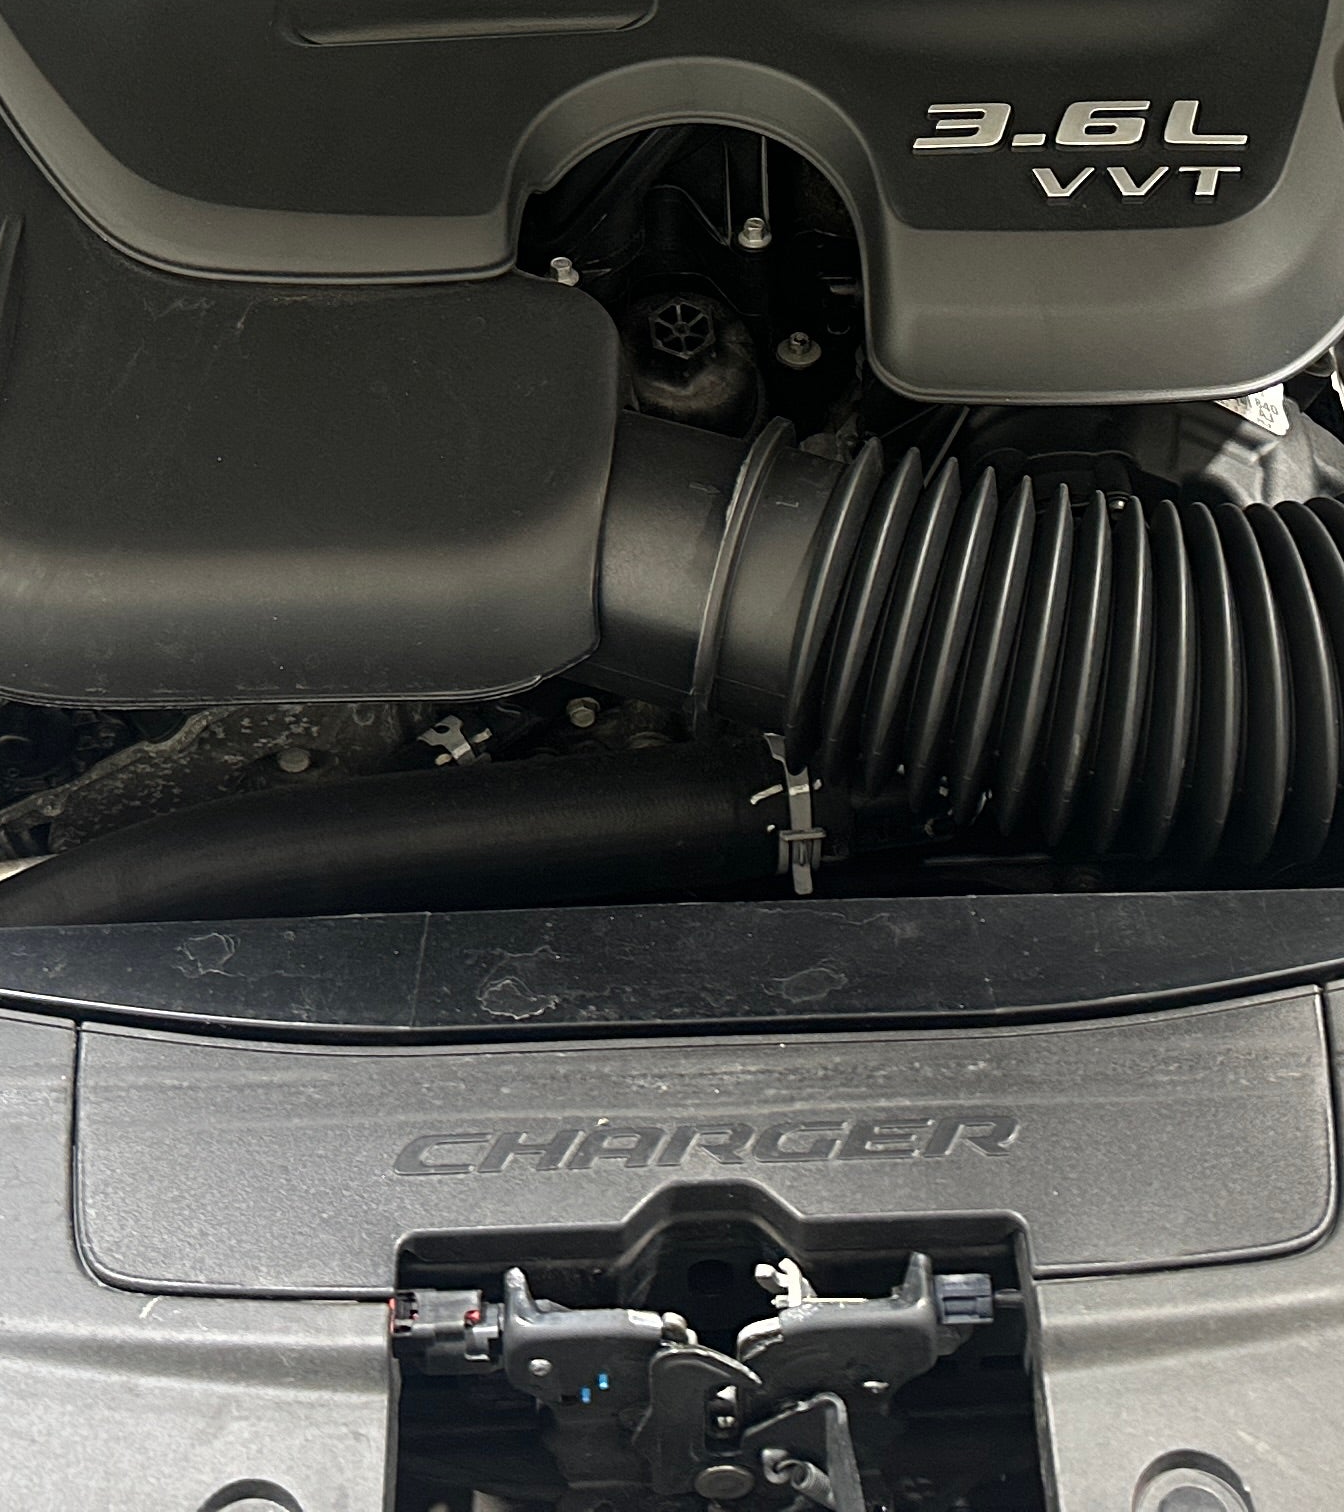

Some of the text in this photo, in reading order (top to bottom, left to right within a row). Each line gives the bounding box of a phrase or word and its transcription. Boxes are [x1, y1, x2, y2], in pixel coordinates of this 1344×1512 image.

[912, 100, 1248, 150] 3.6L
[1031, 166, 1241, 198] VVT
[392, 1114, 1023, 1176] CHARGER
